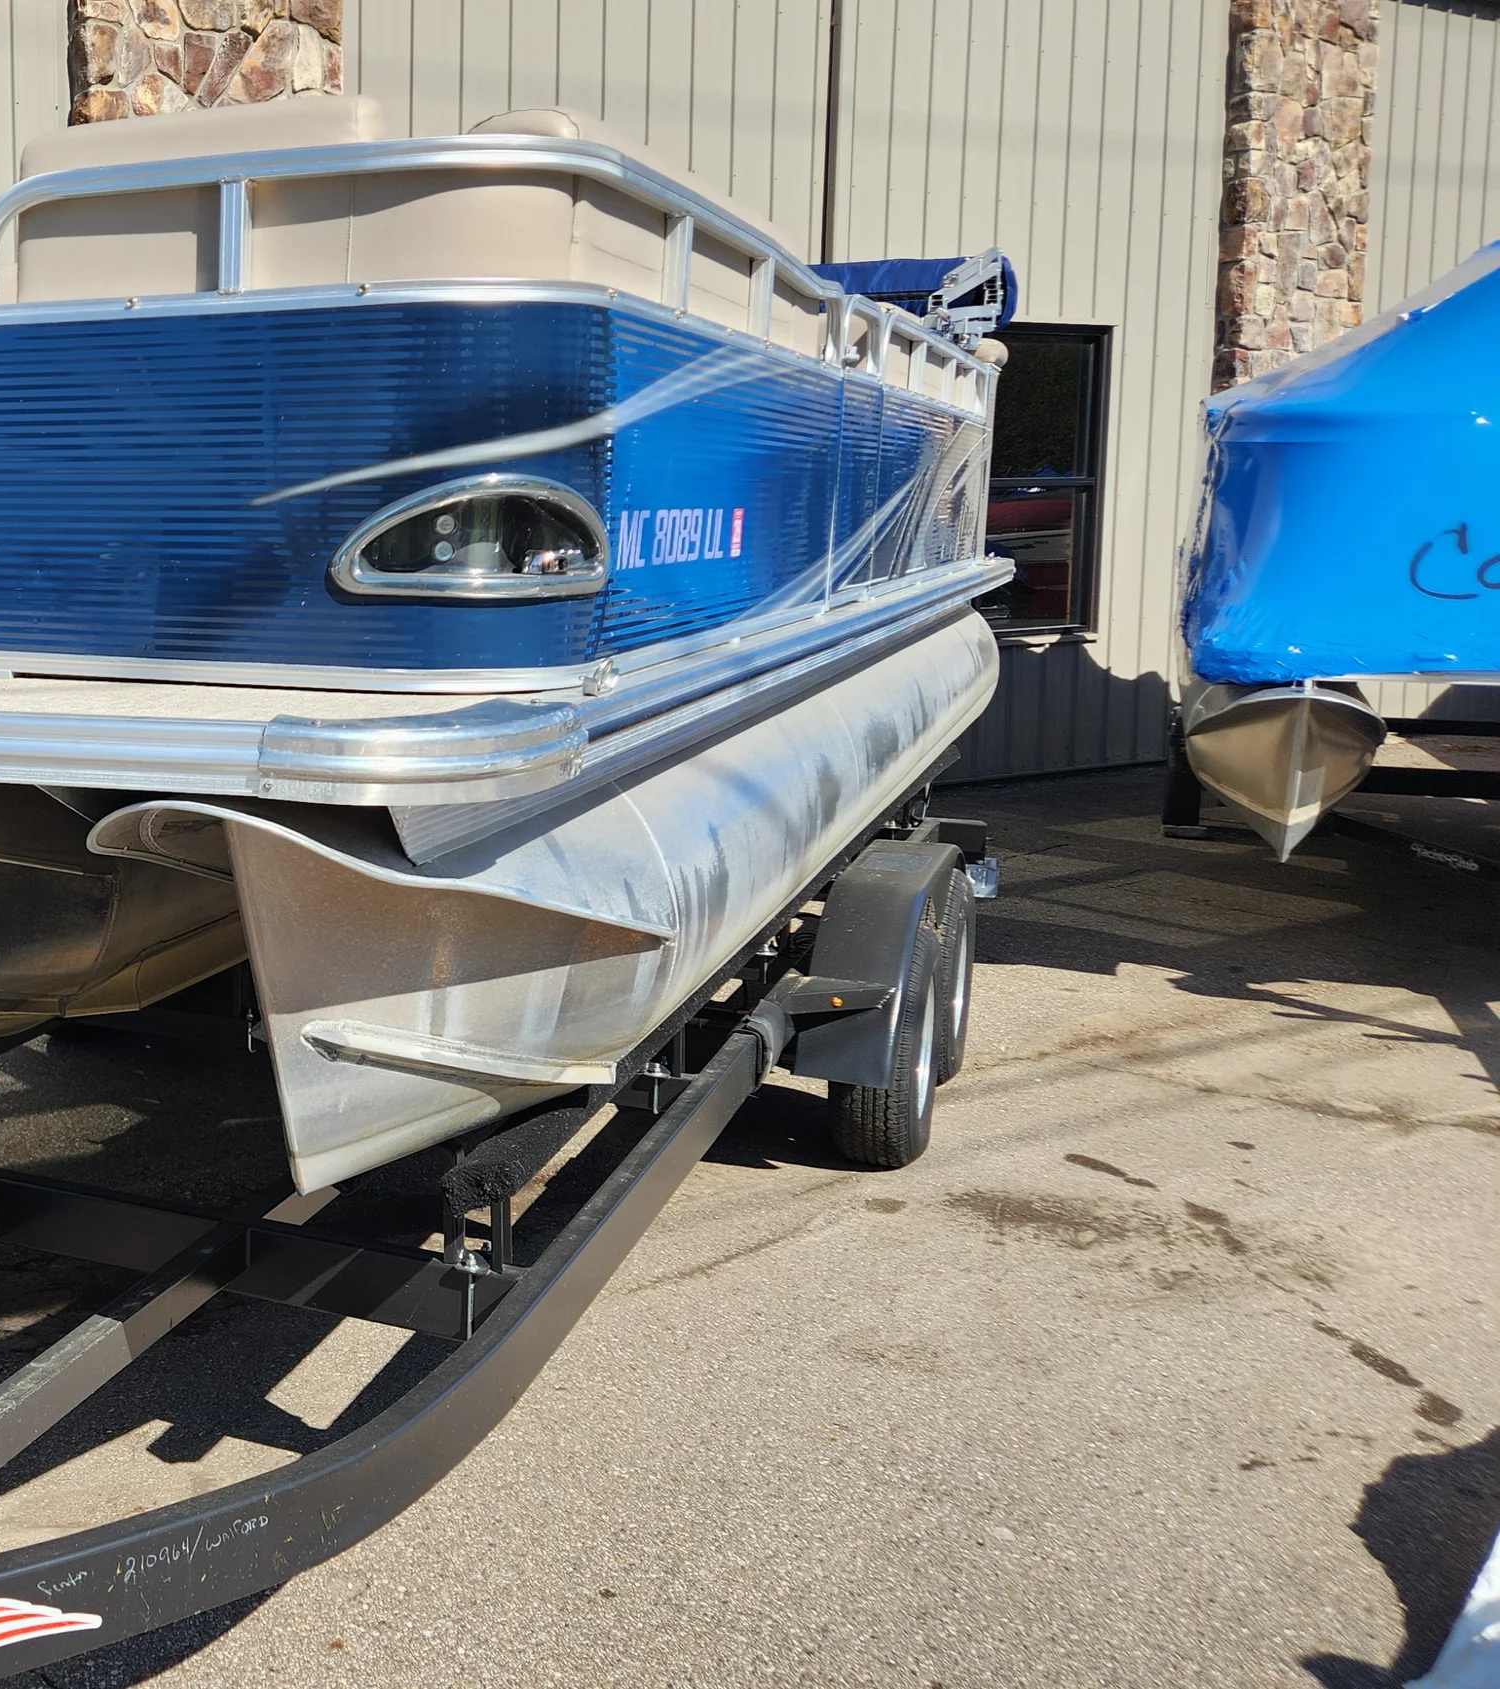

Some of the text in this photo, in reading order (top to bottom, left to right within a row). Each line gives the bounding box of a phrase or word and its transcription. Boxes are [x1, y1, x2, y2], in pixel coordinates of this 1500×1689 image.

[616, 510, 650, 571] MC
[652, 508, 703, 565] 8089
[704, 508, 724, 559] UL
